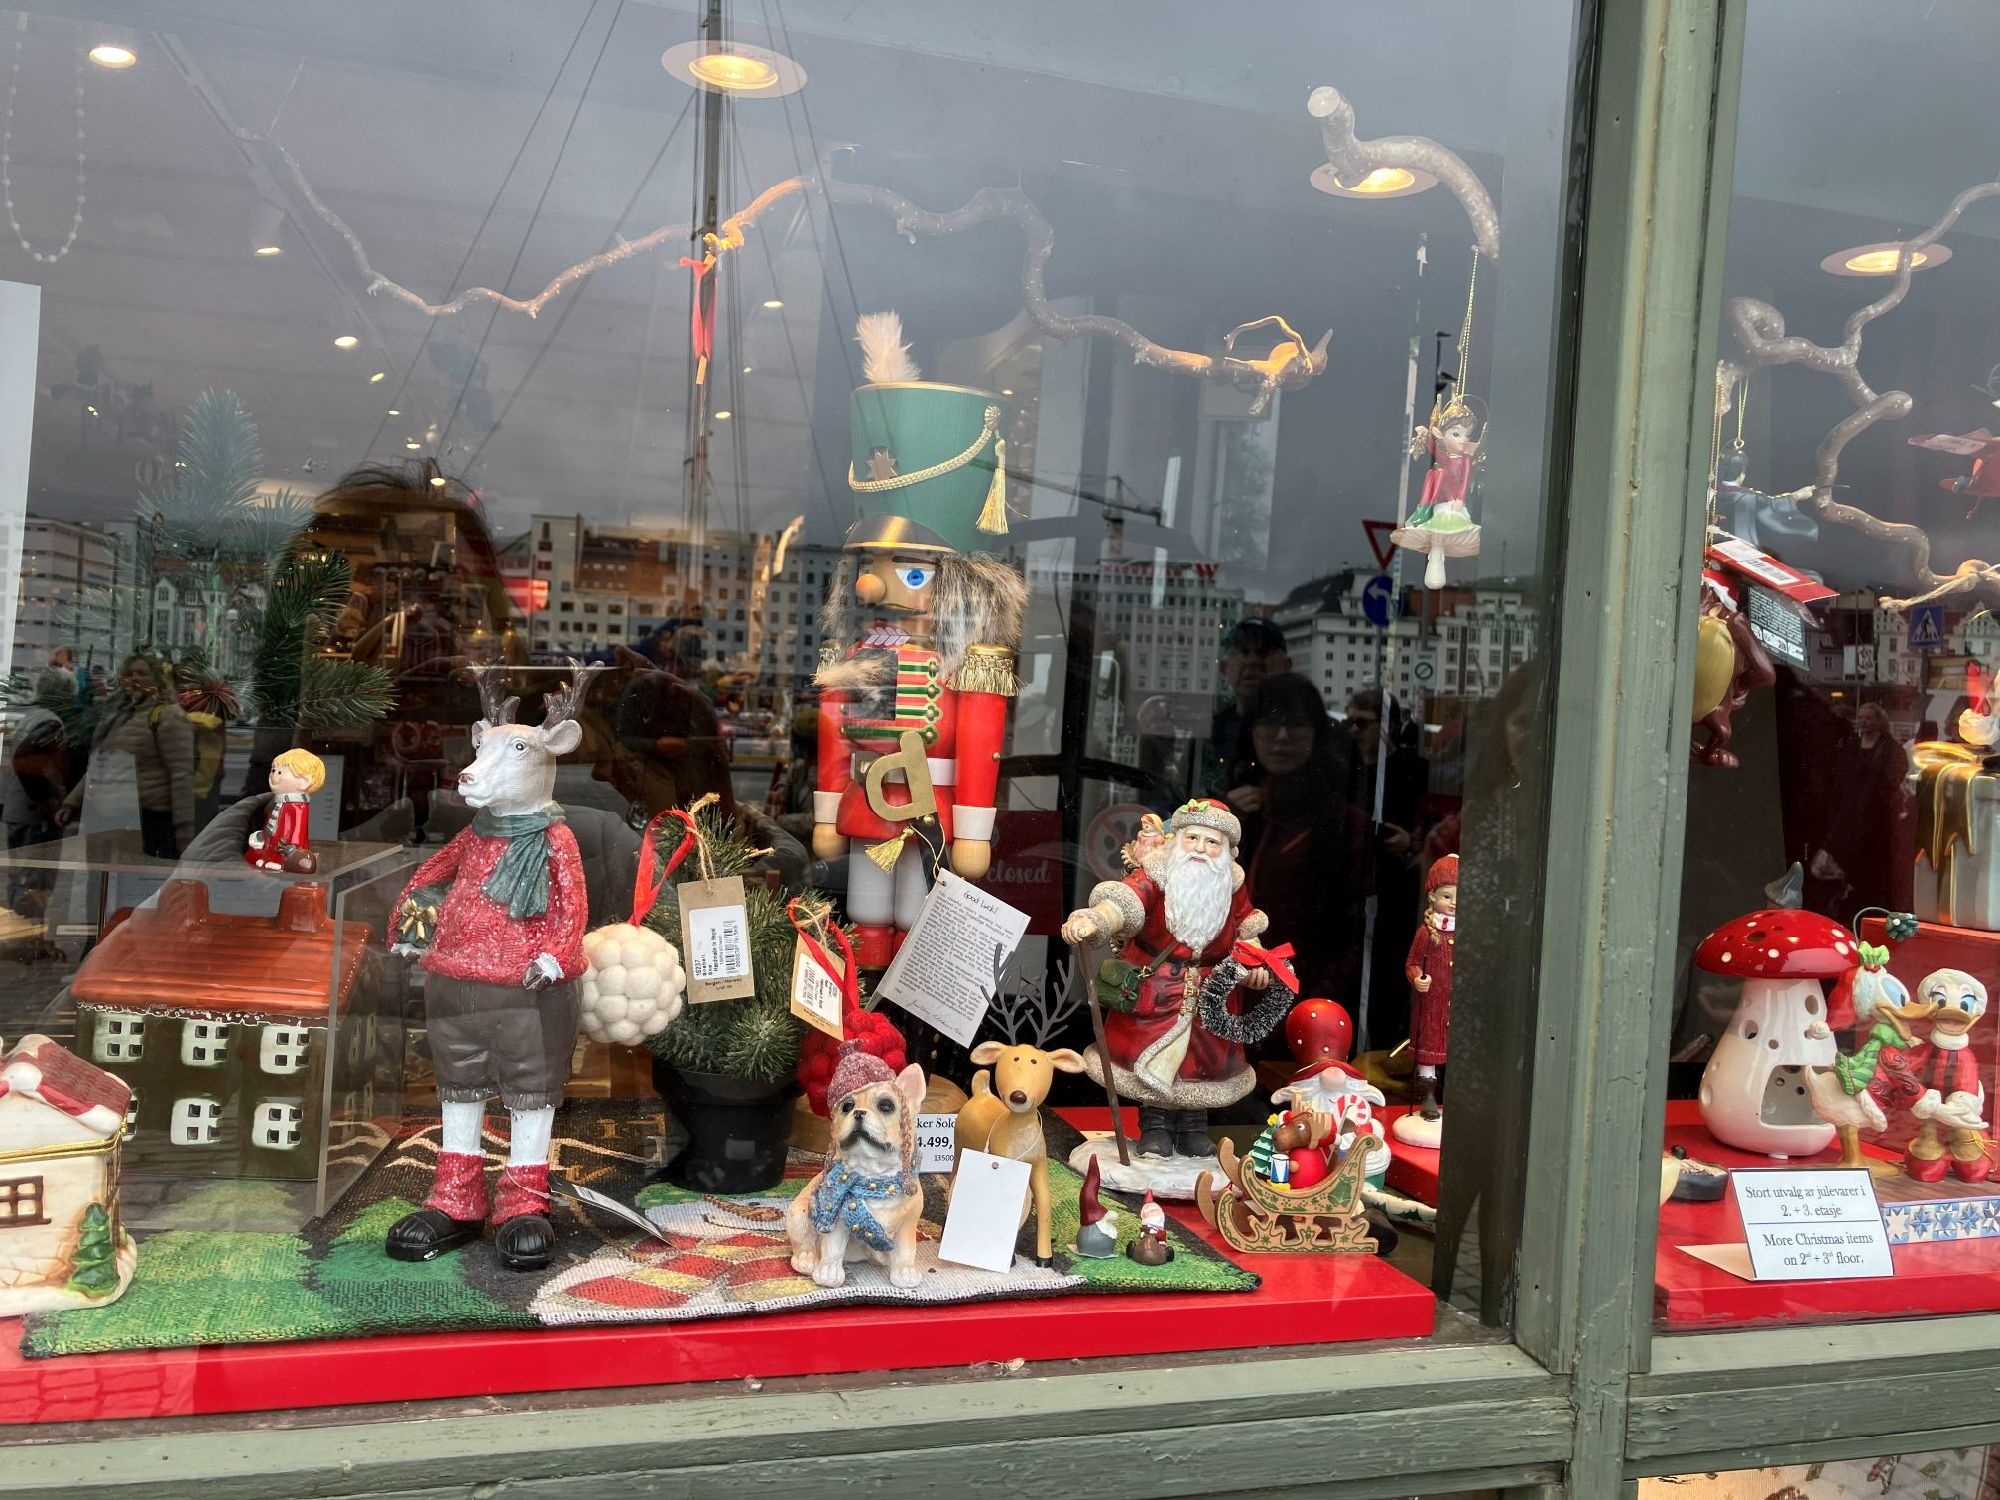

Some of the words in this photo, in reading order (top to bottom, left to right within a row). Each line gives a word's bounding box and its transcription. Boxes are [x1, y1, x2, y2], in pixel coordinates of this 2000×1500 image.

[916, 1117, 934, 1129] ker
[1745, 1186, 1771, 1198] Stort
[1773, 1186, 1804, 1200] utvalg
[1805, 1189, 1815, 1197] av
[1816, 1185, 1859, 1200] julevarer
[1860, 1185, 1866, 1196] i
[1780, 1204, 1792, 1217] 2.
[1793, 1206, 1801, 1214] +
[1803, 1203, 1813, 1217] 3.
[1814, 1203, 1843, 1218] etasje
[1762, 1233, 1794, 1246] More
[1795, 1232, 1845, 1246] Christmas
[1845, 1231, 1875, 1244] items
[1783, 1256, 1798, 1266] on
[1836, 1251, 1865, 1265] floor.
